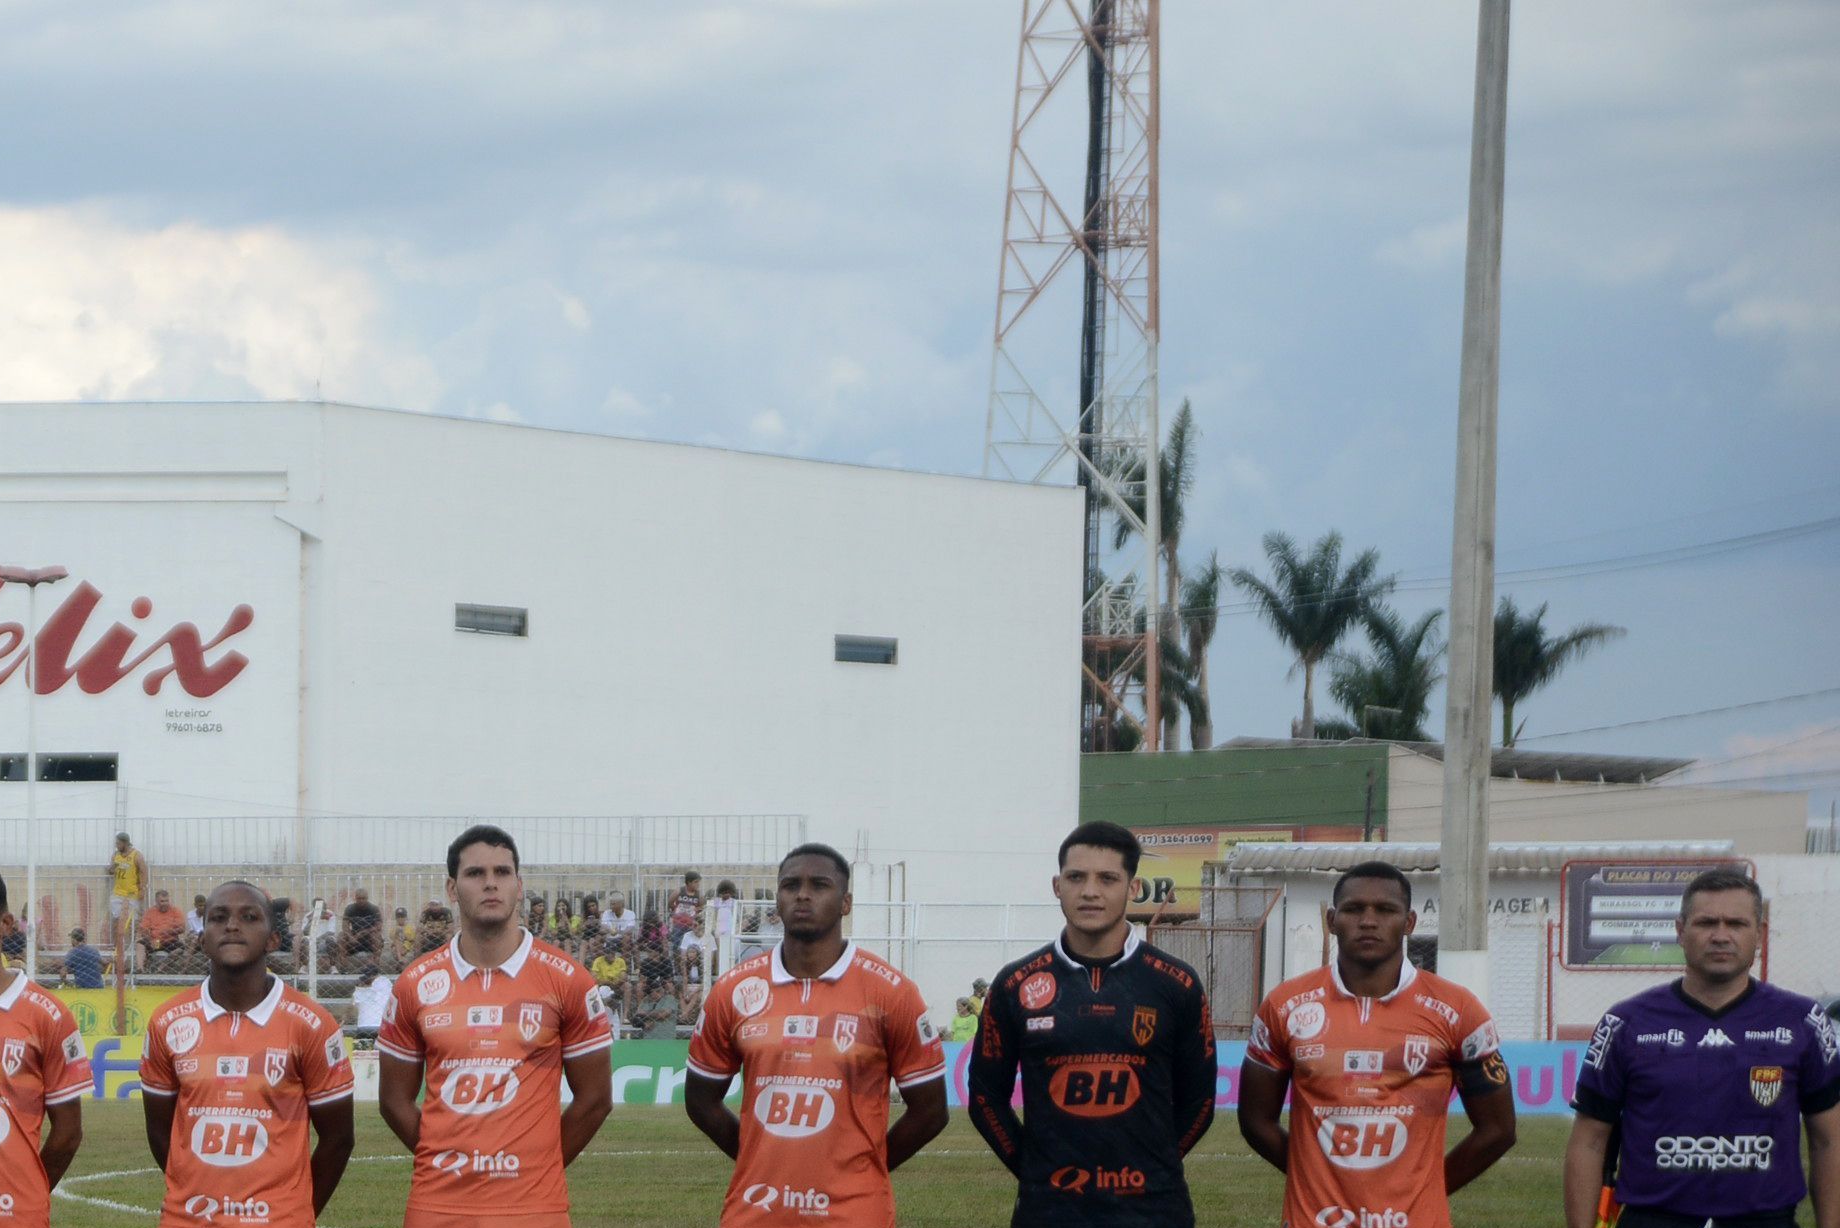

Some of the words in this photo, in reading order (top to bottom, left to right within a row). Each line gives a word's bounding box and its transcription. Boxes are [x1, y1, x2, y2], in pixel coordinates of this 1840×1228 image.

[452, 1071, 511, 1105] BH
[1064, 1070, 1130, 1106] BH
[188, 1106, 273, 1119] SUPERMERCADOS
[766, 1091, 824, 1128] BH
[1313, 1104, 1415, 1117] SUPERMERCADOS
[201, 1122, 258, 1157] BH
[1330, 1122, 1397, 1158] BH
[1655, 1135, 1774, 1154] ODONTO
[473, 1149, 520, 1171] info
[1656, 1152, 1770, 1170] company
[1096, 1165, 1146, 1188] info
[223, 1196, 270, 1217] info
[783, 1185, 830, 1208] info
